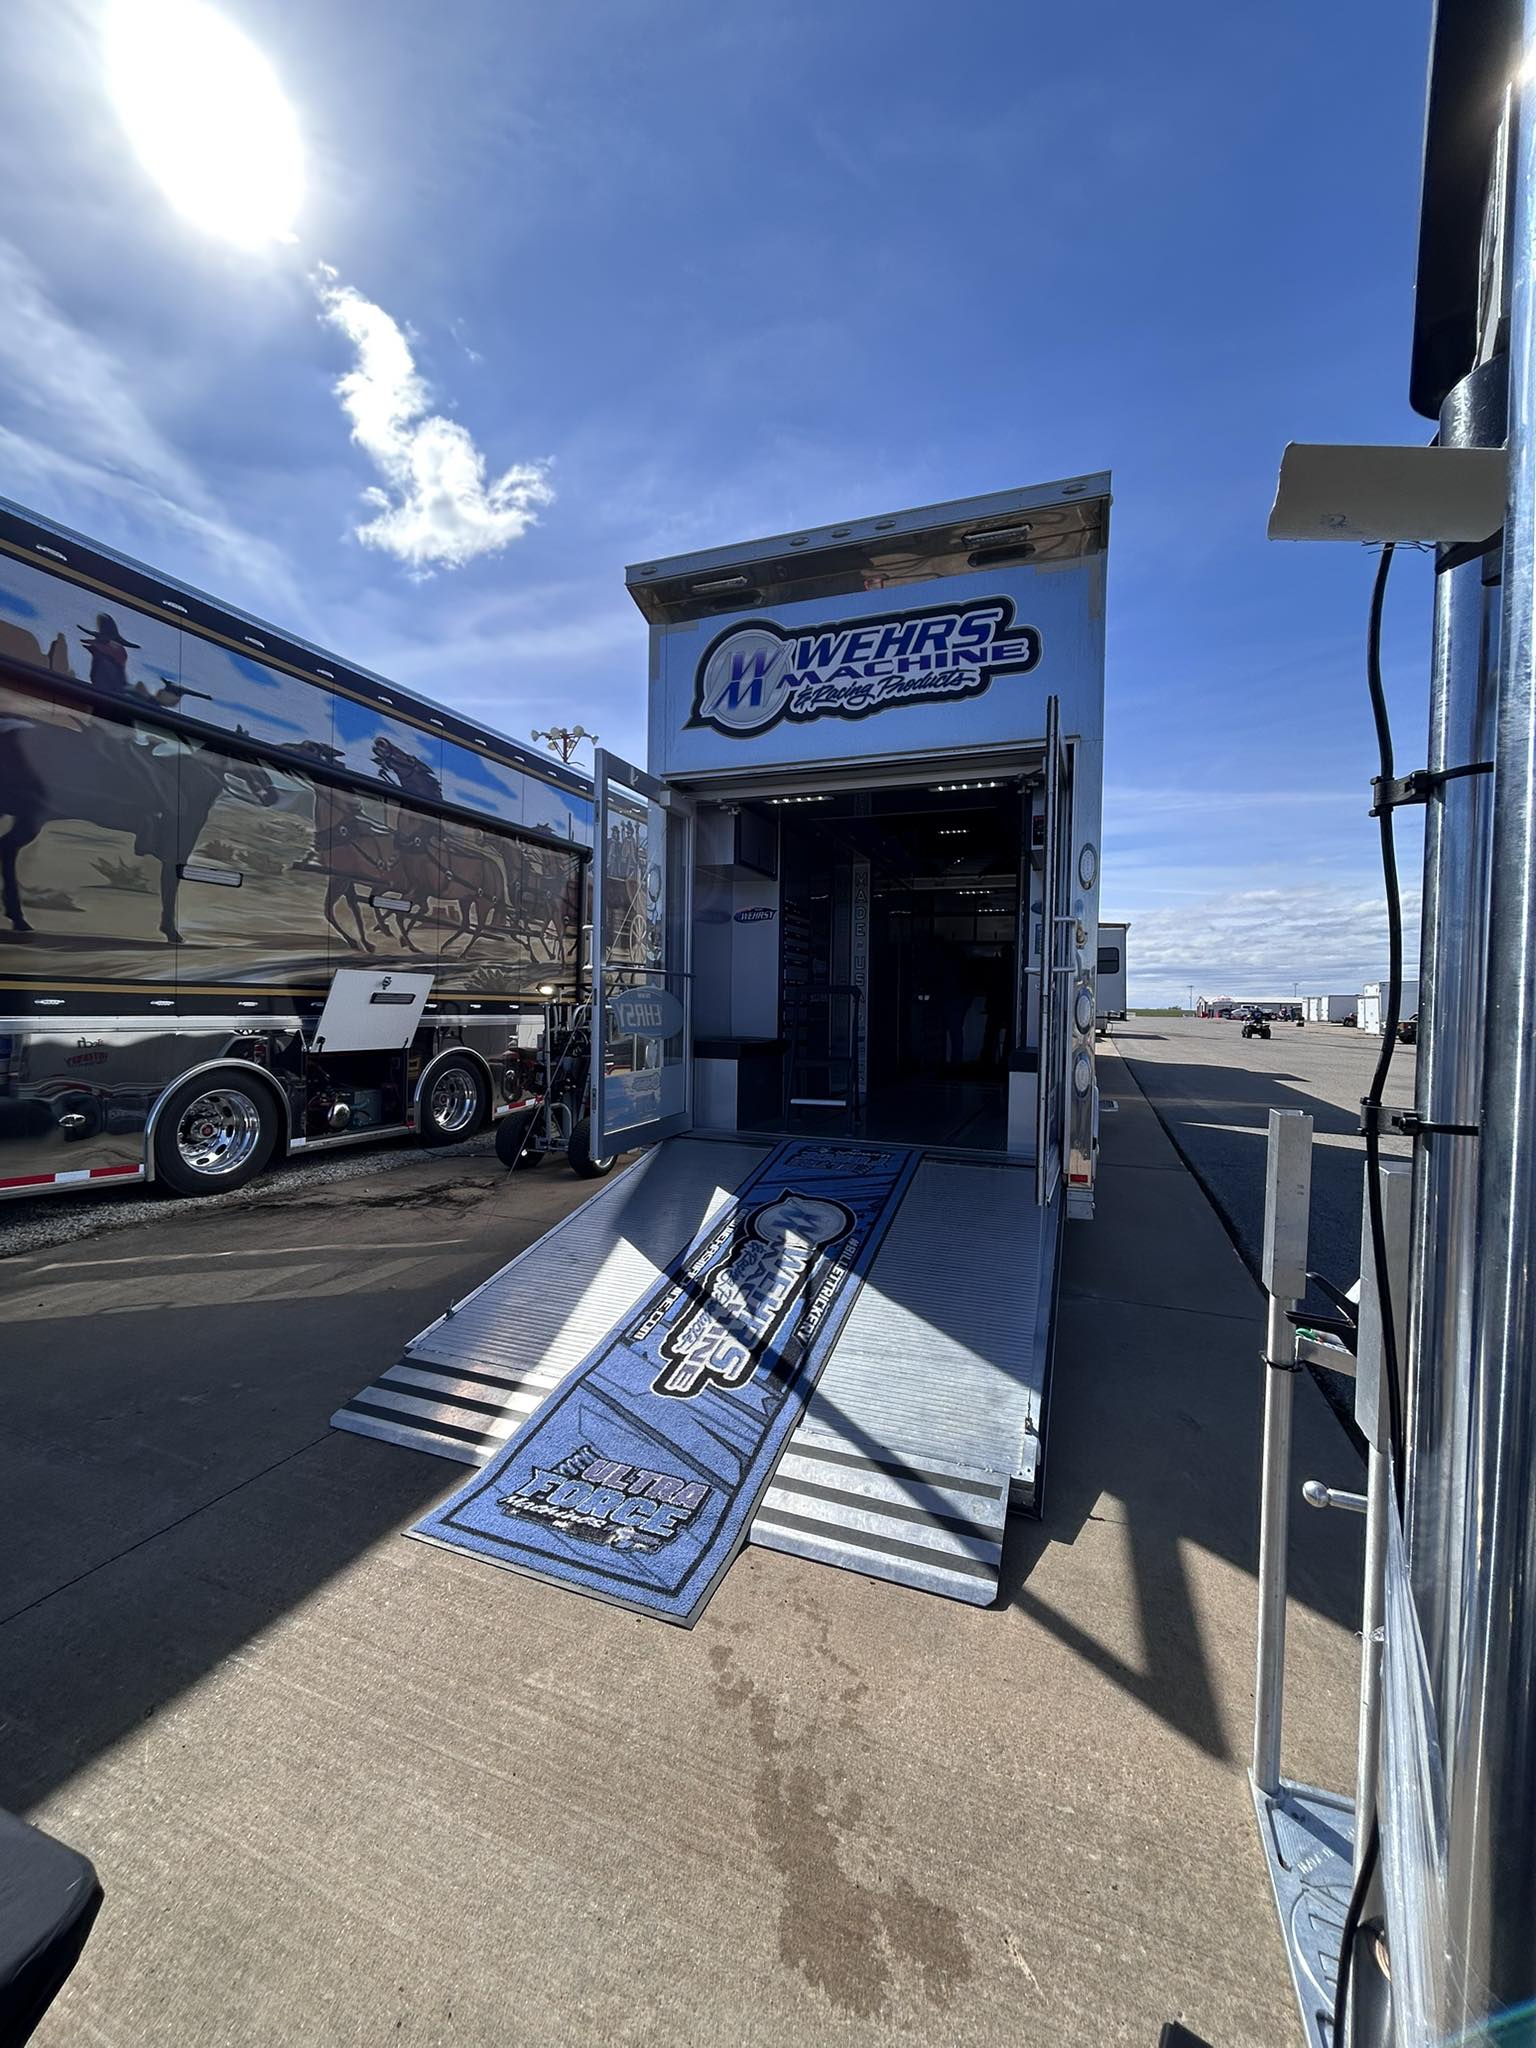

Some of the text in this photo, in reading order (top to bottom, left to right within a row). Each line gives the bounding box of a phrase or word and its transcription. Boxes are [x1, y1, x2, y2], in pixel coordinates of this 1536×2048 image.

[776, 640, 1028, 688] MACHINE
[798, 608, 1003, 671] WEHRS
[812, 680, 874, 706] Racing
[876, 669, 977, 697] Products
[854, 871, 868, 937] MADE
[670, 1236, 787, 1387] MACHINE
[709, 1243, 809, 1380] WEHRS
[797, 1238, 860, 1345] #BILLETTRICKERY
[514, 1468, 692, 1538] FORCE
[581, 1458, 710, 1510] ULTRA
